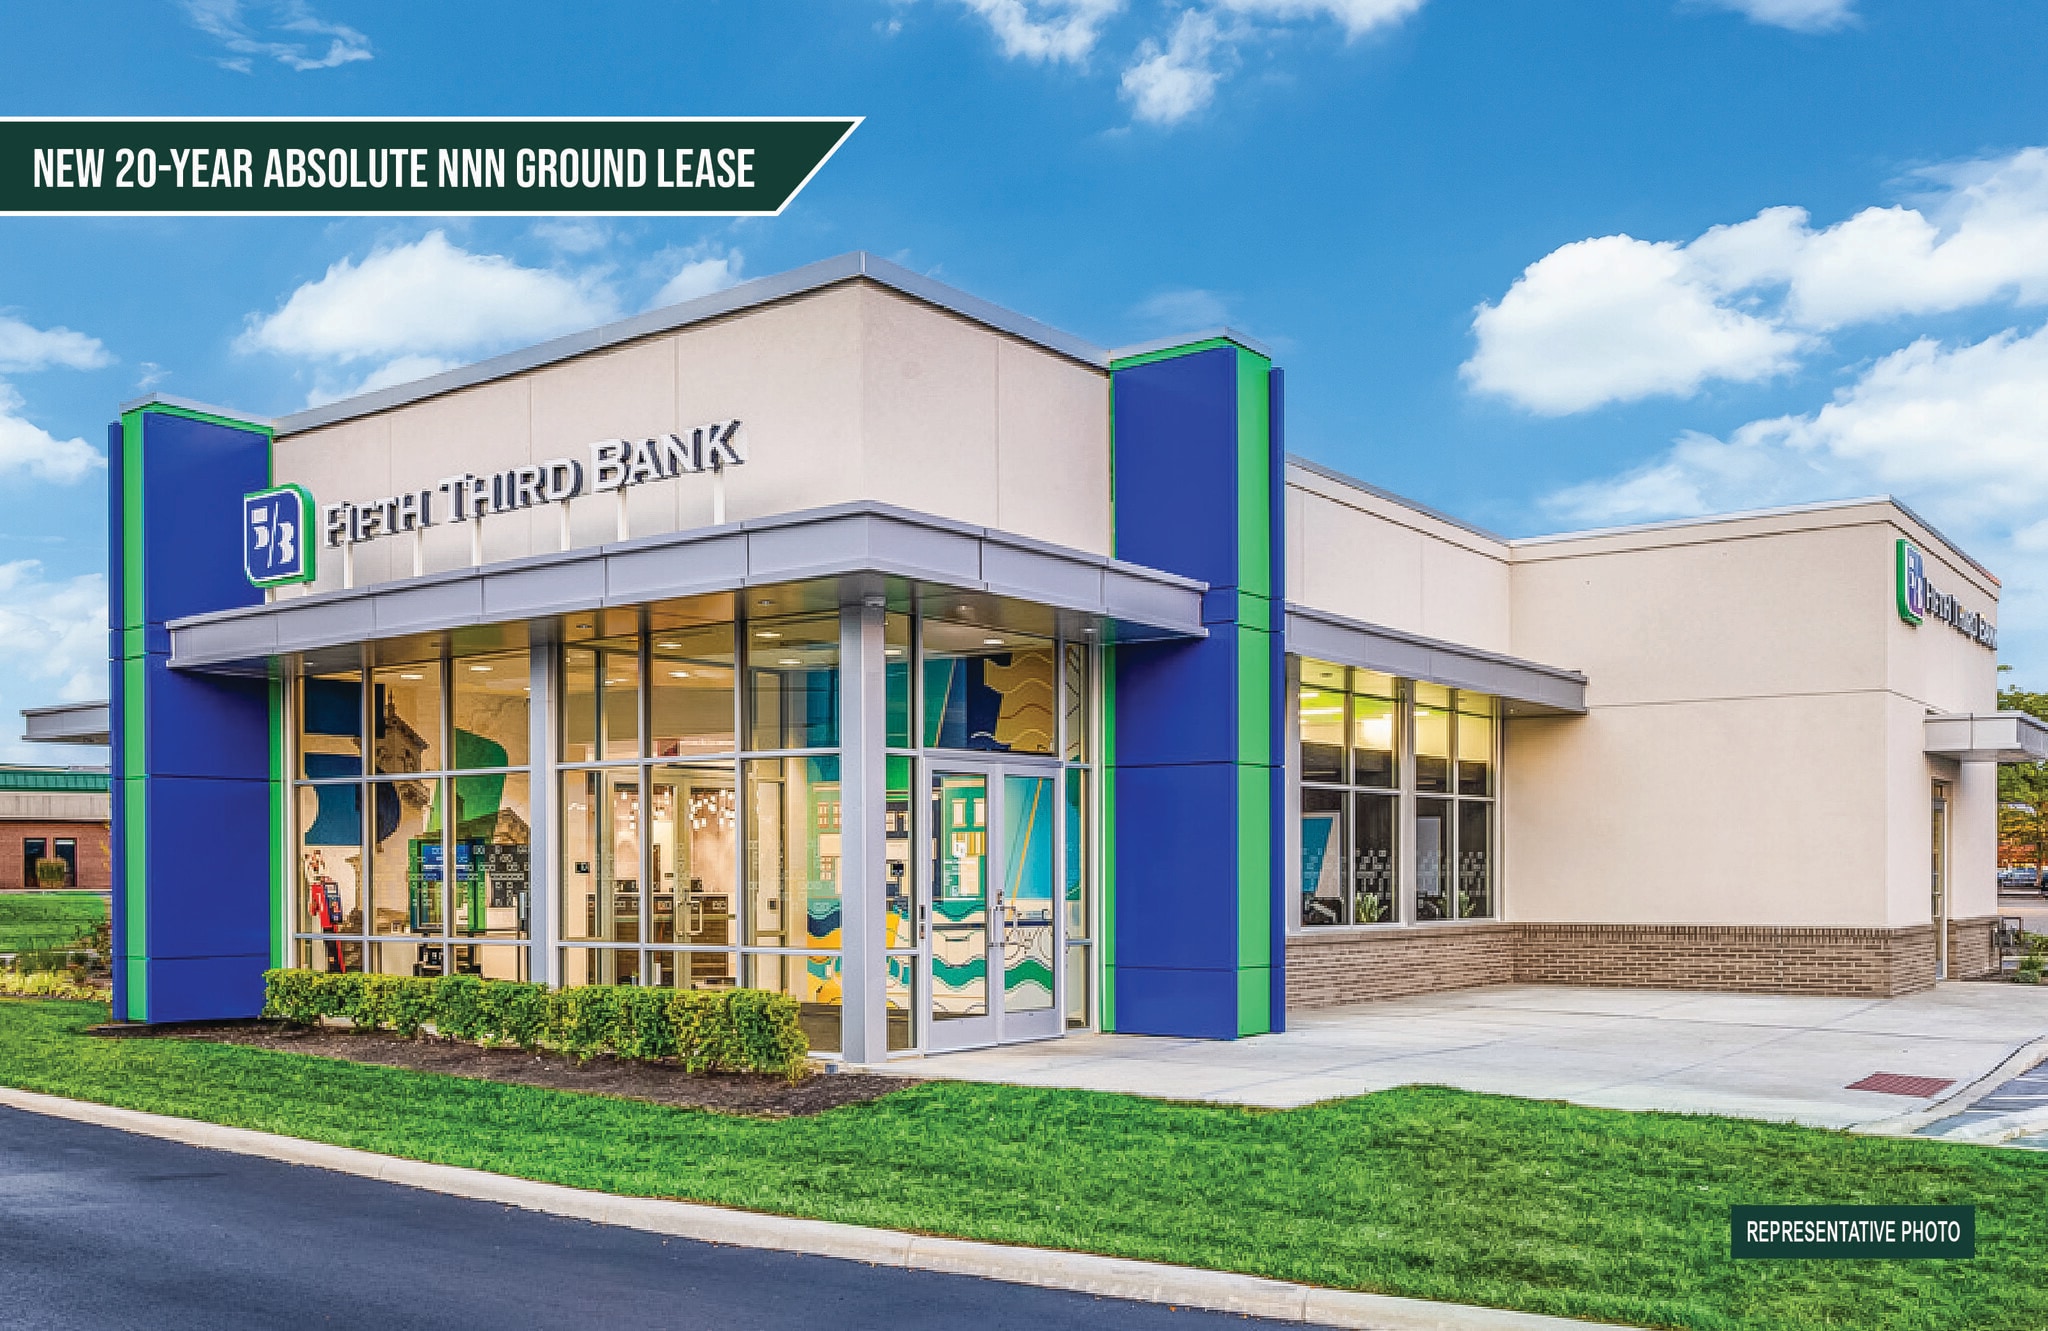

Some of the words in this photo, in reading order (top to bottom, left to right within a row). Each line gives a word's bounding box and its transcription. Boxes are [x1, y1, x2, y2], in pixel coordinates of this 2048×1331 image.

[322, 490, 432, 547] FIFTH
[438, 458, 584, 523] THIRD
[589, 419, 746, 493] BANK
